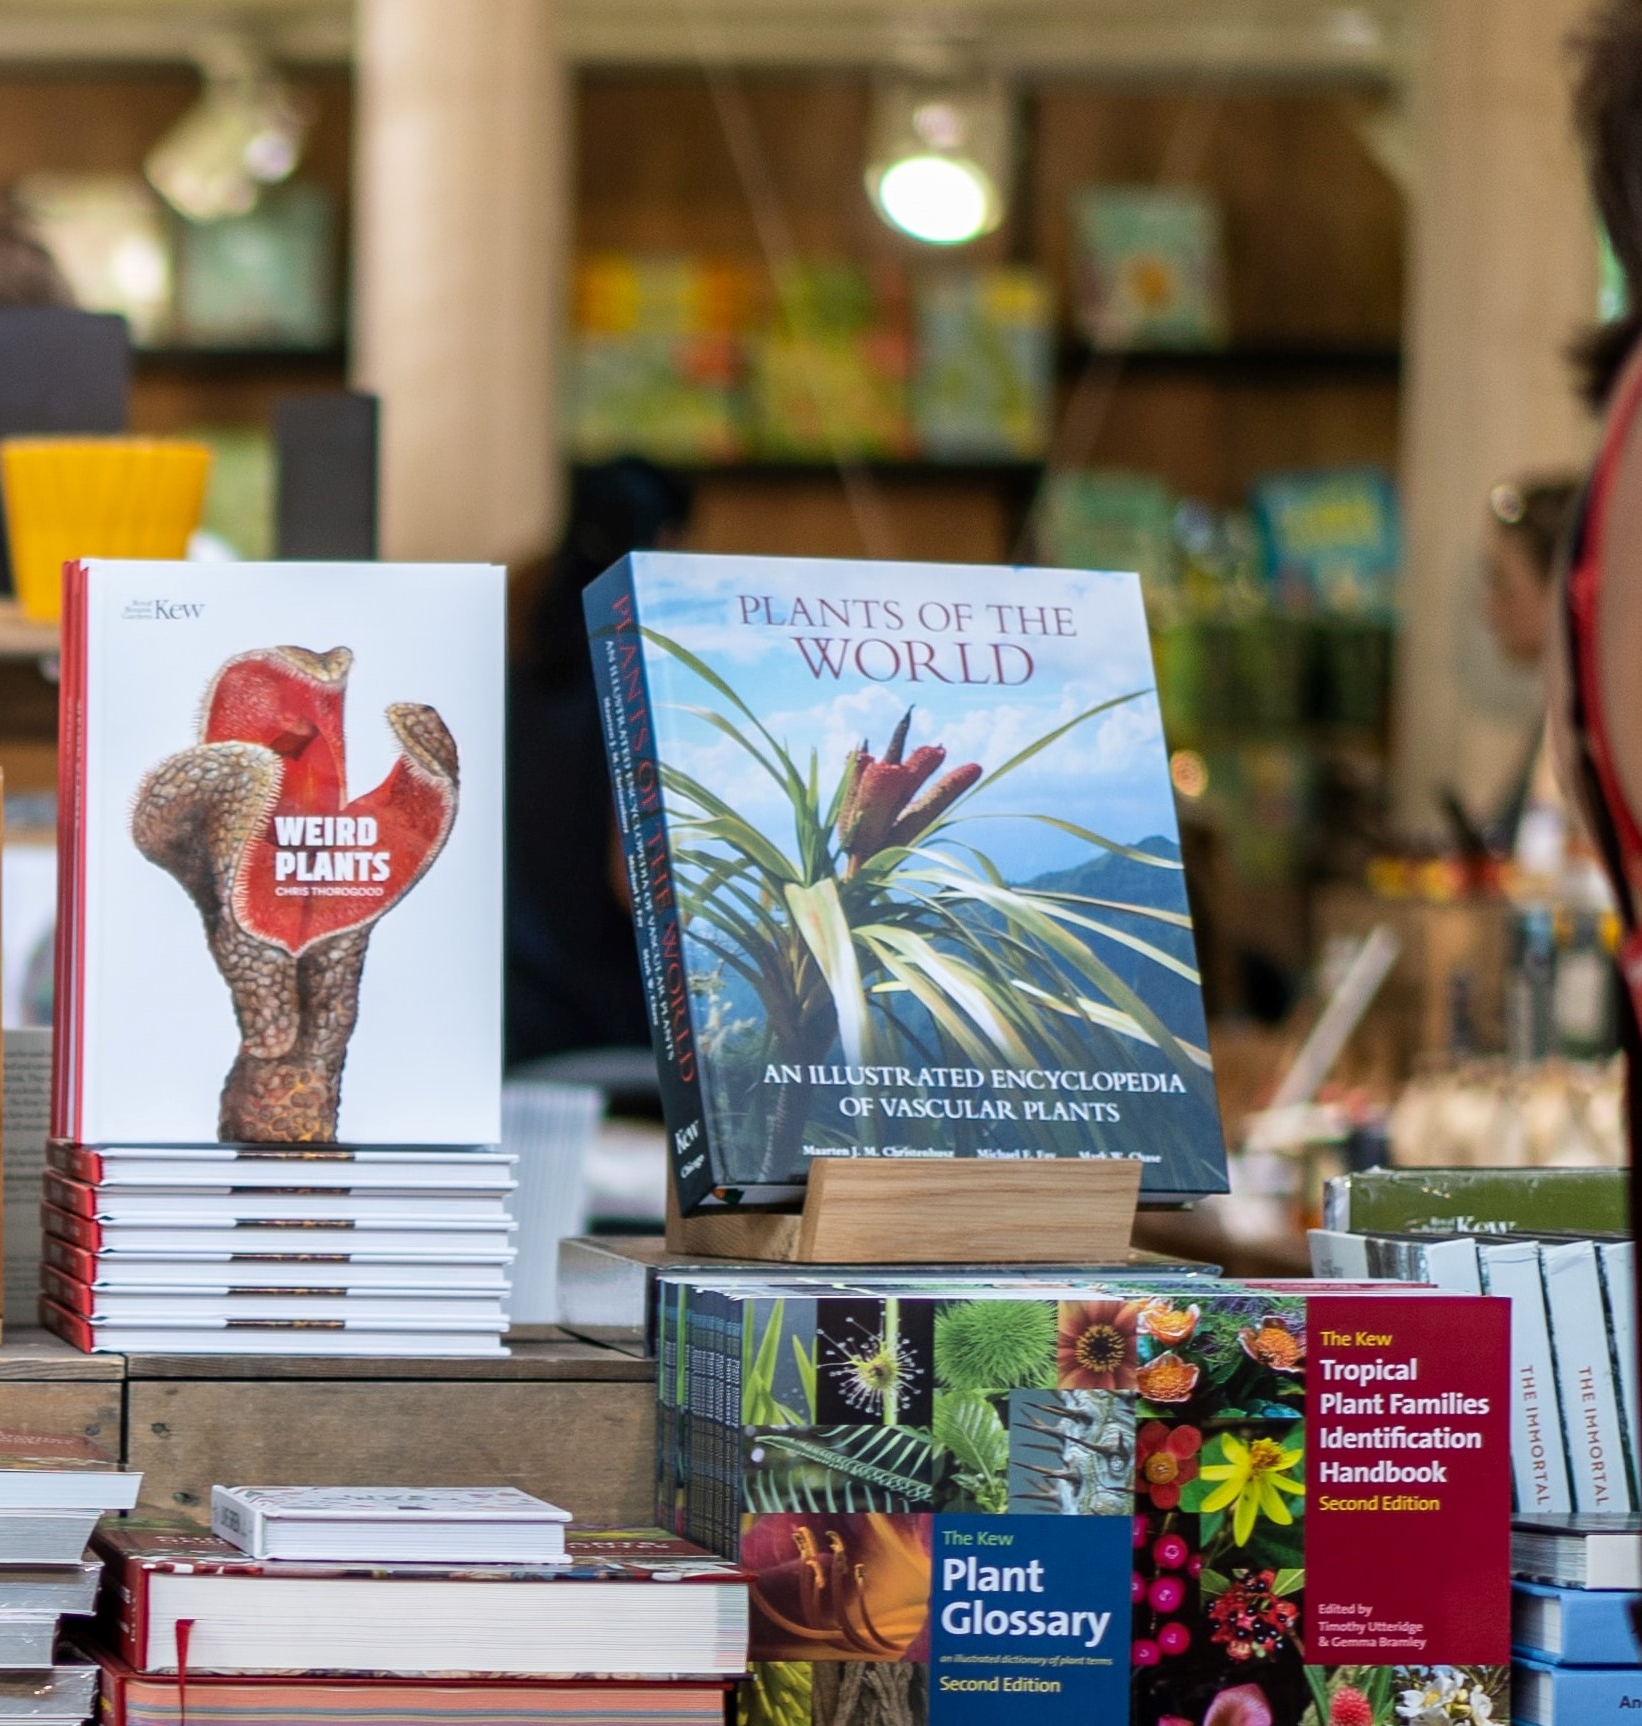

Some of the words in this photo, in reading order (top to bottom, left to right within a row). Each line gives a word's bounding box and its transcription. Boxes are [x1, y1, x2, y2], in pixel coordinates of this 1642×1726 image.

[155, 599, 206, 620] Kew
[736, 595, 904, 630] PLANTS
[918, 602, 973, 632] OF
[986, 605, 1078, 637] THE
[789, 636, 1035, 686] WORLD
[274, 816, 378, 846] WEIRD
[275, 851, 391, 881] PLANTS
[275, 887, 309, 897] CHRIS
[312, 887, 384, 897] THOROGOOD
[764, 1065, 802, 1085] AN
[809, 1066, 984, 1088] ILLUSTRATED
[991, 1069, 1187, 1094] ENCYCLOPEDIA
[839, 1098, 874, 1117] OF
[880, 1098, 1018, 1120] VASCULAR
[1025, 1101, 1121, 1123] PLANTS
[674, 1119, 699, 1155] Kew
[1320, 1331, 1352, 1346] The
[1356, 1332, 1393, 1346] Kew
[1319, 1358, 1418, 1387] Tropical
[1521, 1365, 1538, 1401] THE
[1578, 1366, 1596, 1402] THE
[1319, 1393, 1385, 1415] Plant
[1389, 1392, 1490, 1415] Families
[1320, 1426, 1483, 1449] Identification
[1525, 1407, 1551, 1505] IMMORTAL
[1584, 1408, 1610, 1506] IMMORTAL
[1319, 1461, 1448, 1483] Handbook
[1319, 1496, 1378, 1511] Second
[1382, 1496, 1440, 1511] Edition
[942, 1530, 973, 1546] The
[977, 1531, 1014, 1546] Kew
[943, 1556, 1045, 1593] Plant
[1318, 1604, 1355, 1615] Edited
[1358, 1604, 1373, 1617] by
[941, 1600, 1112, 1648] Glossary
[1318, 1621, 1366, 1635] Timothy
[1368, 1621, 1424, 1635] Utteridge
[1318, 1637, 1329, 1648] &
[1330, 1637, 1377, 1648] Gemma
[1379, 1637, 1427, 1650] Bramley
[939, 1655, 952, 1663] an
[953, 1654, 999, 1664] illustrated
[1001, 1655, 1047, 1667] dictionary
[1048, 1655, 1060, 1666] of
[1060, 1655, 1085, 1667] plant
[1085, 1657, 1113, 1666] terms
[939, 1676, 999, 1692] Second
[1003, 1677, 1062, 1693] Edition
